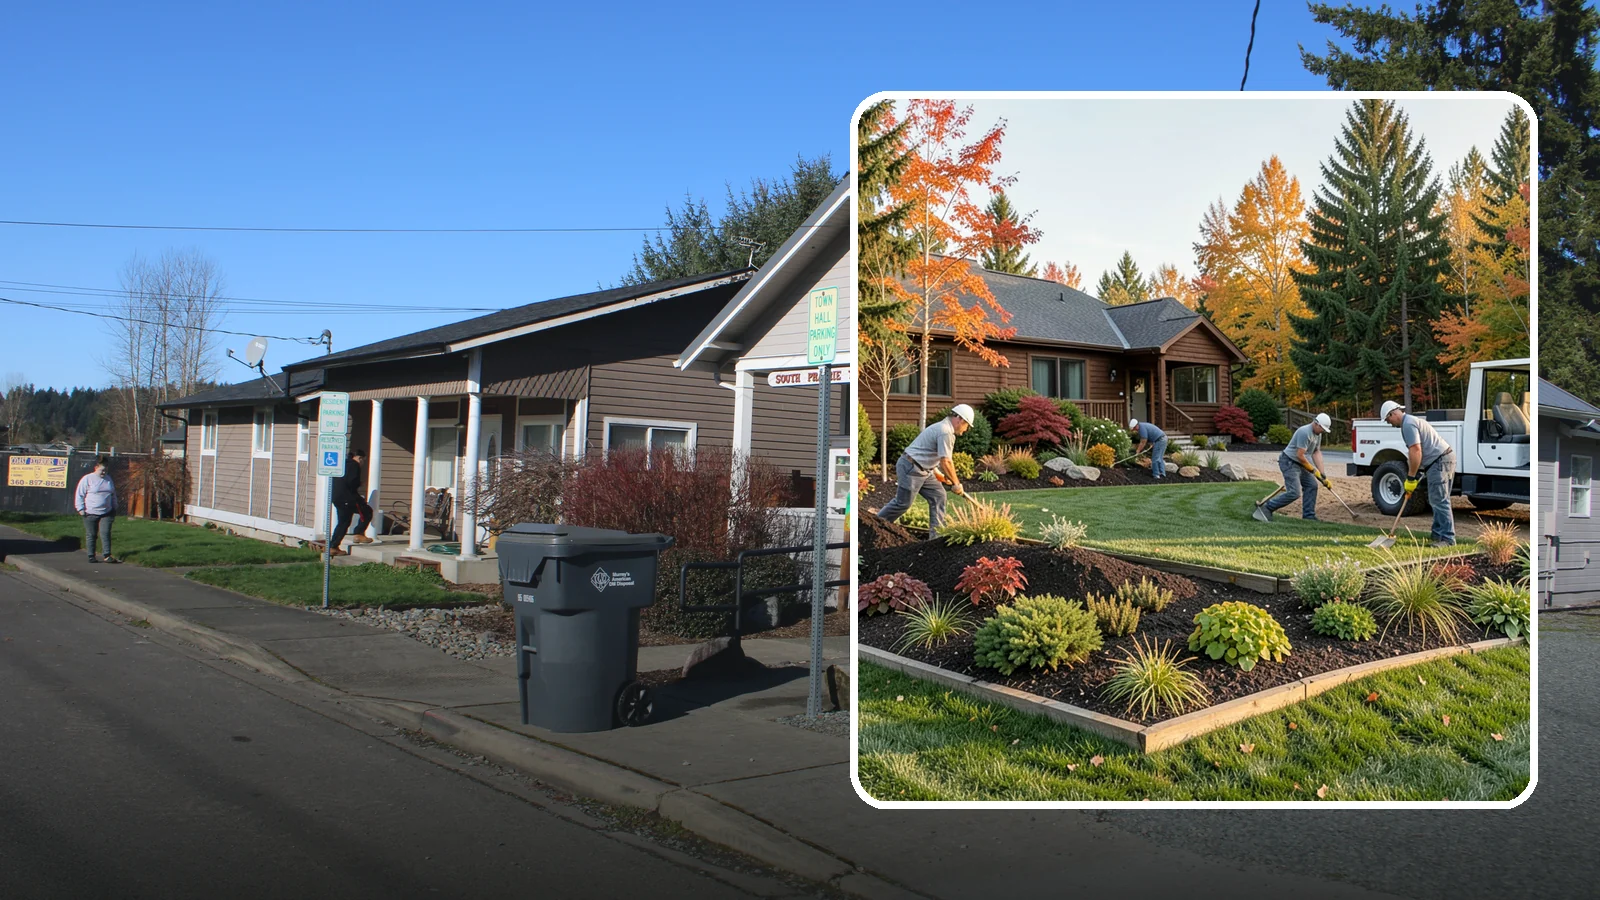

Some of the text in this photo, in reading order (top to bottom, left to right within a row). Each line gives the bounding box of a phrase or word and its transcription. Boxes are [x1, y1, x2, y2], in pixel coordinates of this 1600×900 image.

[815, 295, 833, 308] TOWN
[814, 311, 832, 325] HALL
[810, 326, 836, 341] PARKING
[813, 344, 831, 357] ONLY
[776, 374, 801, 384] SOUTH
[808, 371, 841, 382] PRIE
